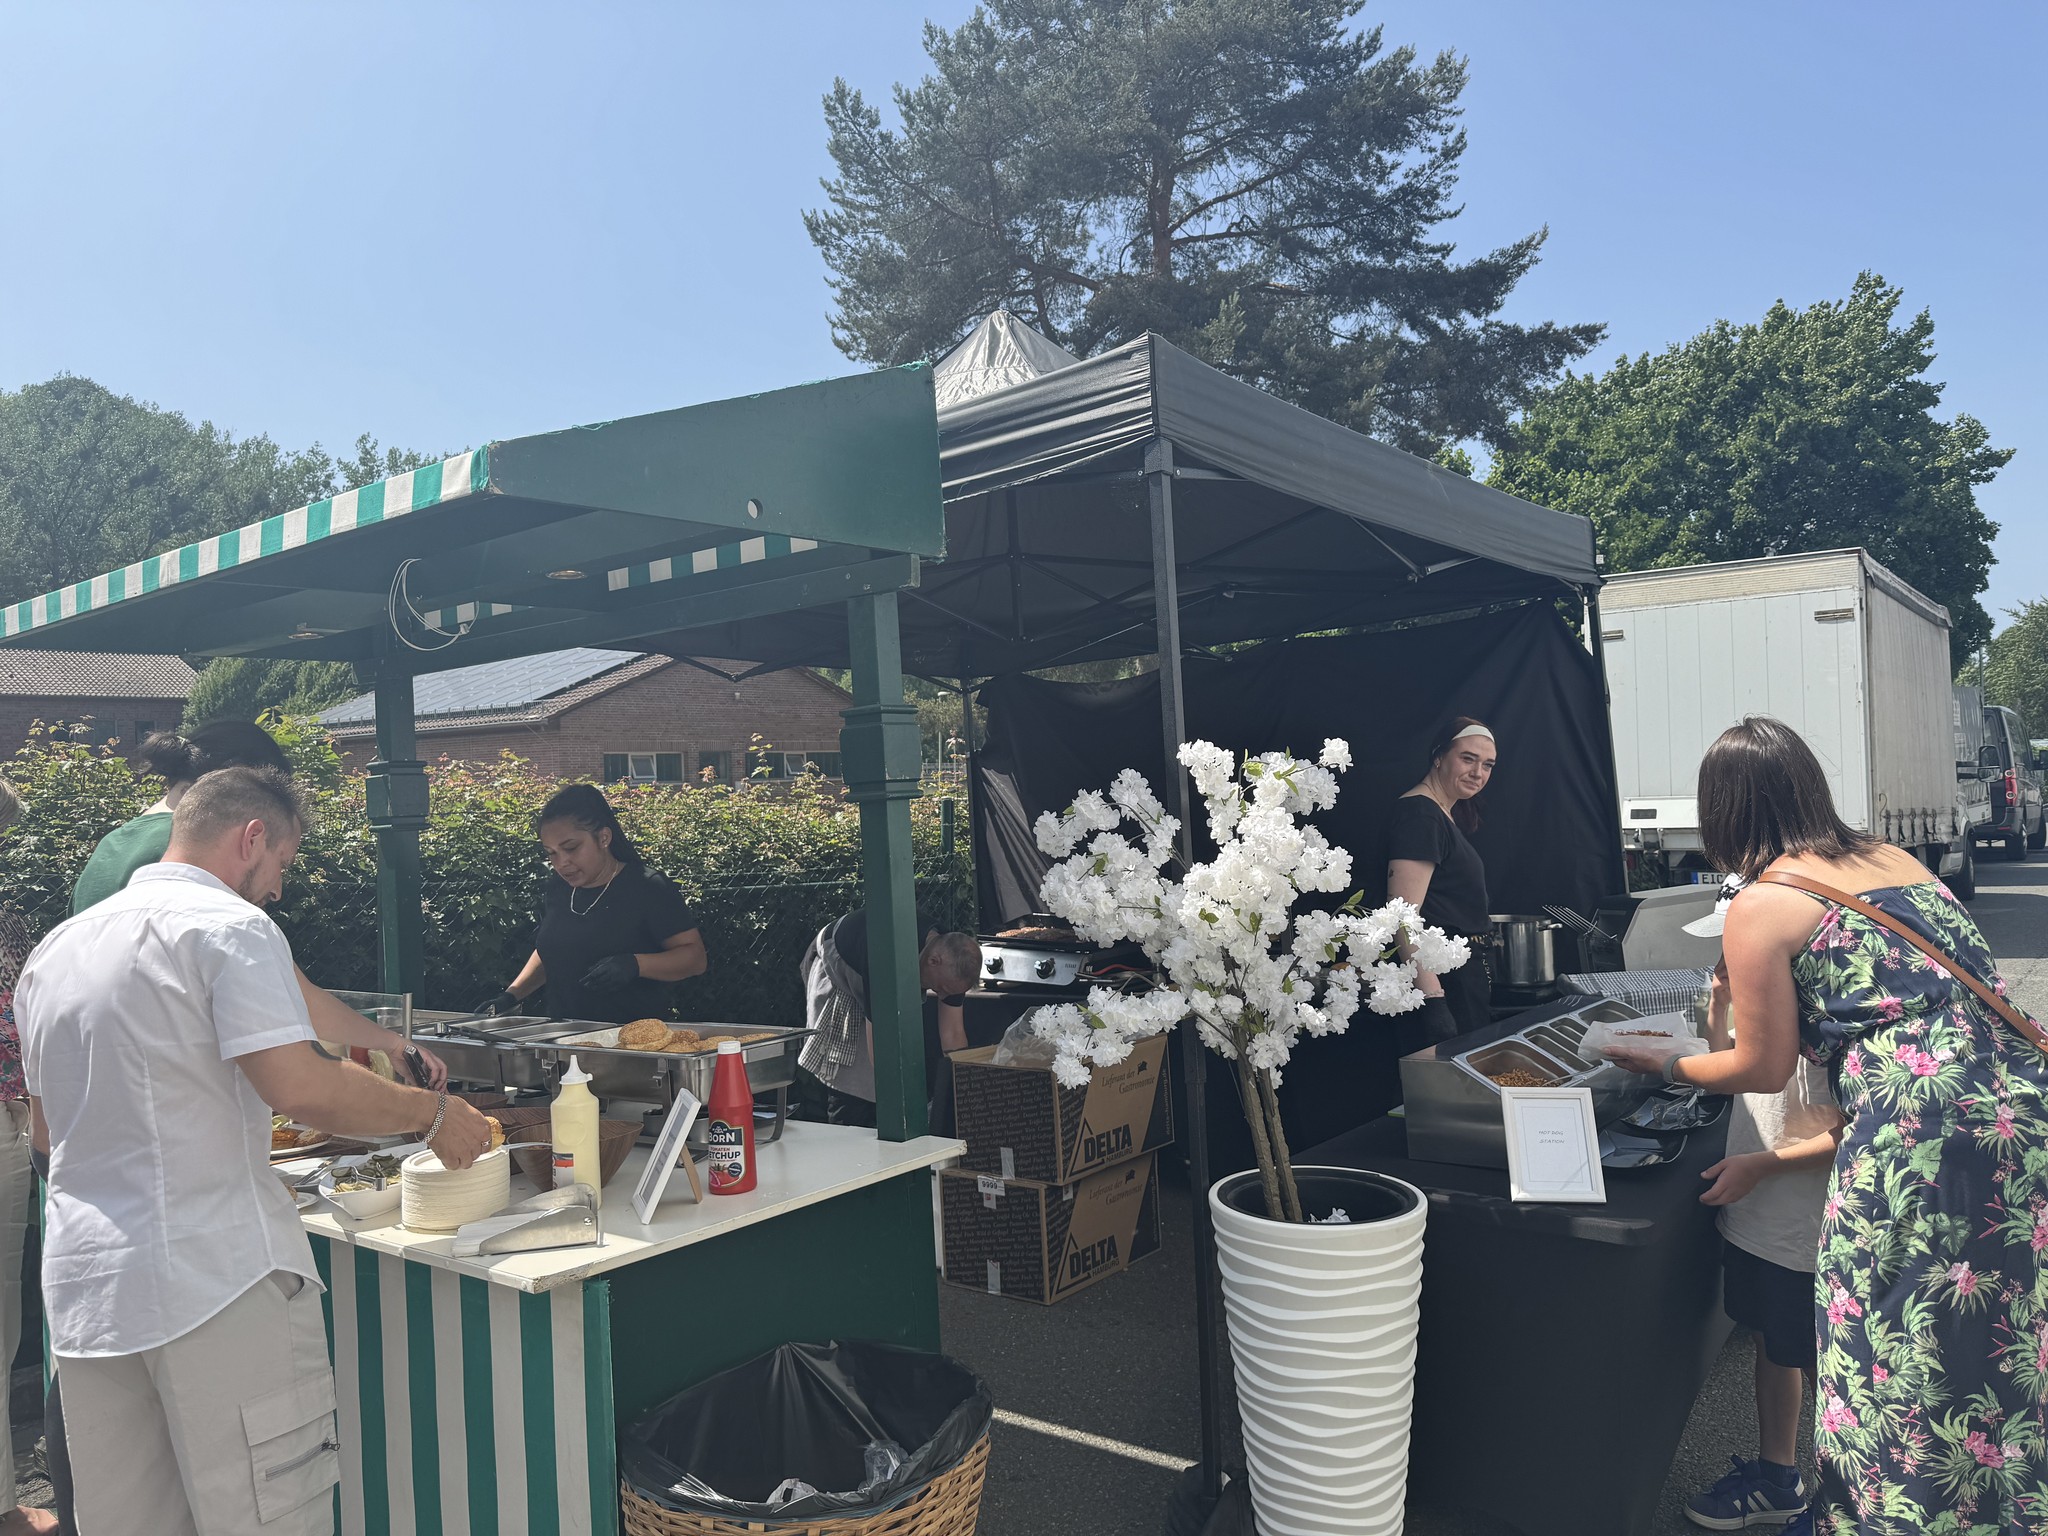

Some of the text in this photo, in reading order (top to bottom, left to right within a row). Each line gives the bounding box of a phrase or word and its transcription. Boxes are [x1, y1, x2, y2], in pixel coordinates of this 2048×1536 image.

[1702, 874, 1723, 884] EIC
[1119, 1076, 1155, 1094] Gastronomie
[1084, 1124, 1132, 1164] DELTA
[709, 1151, 741, 1160] ETCHUP
[1106, 1146, 1133, 1163] HAMBURG
[1069, 1234, 1119, 1279] DELTA
[1092, 1258, 1120, 1277] HAMBURG
